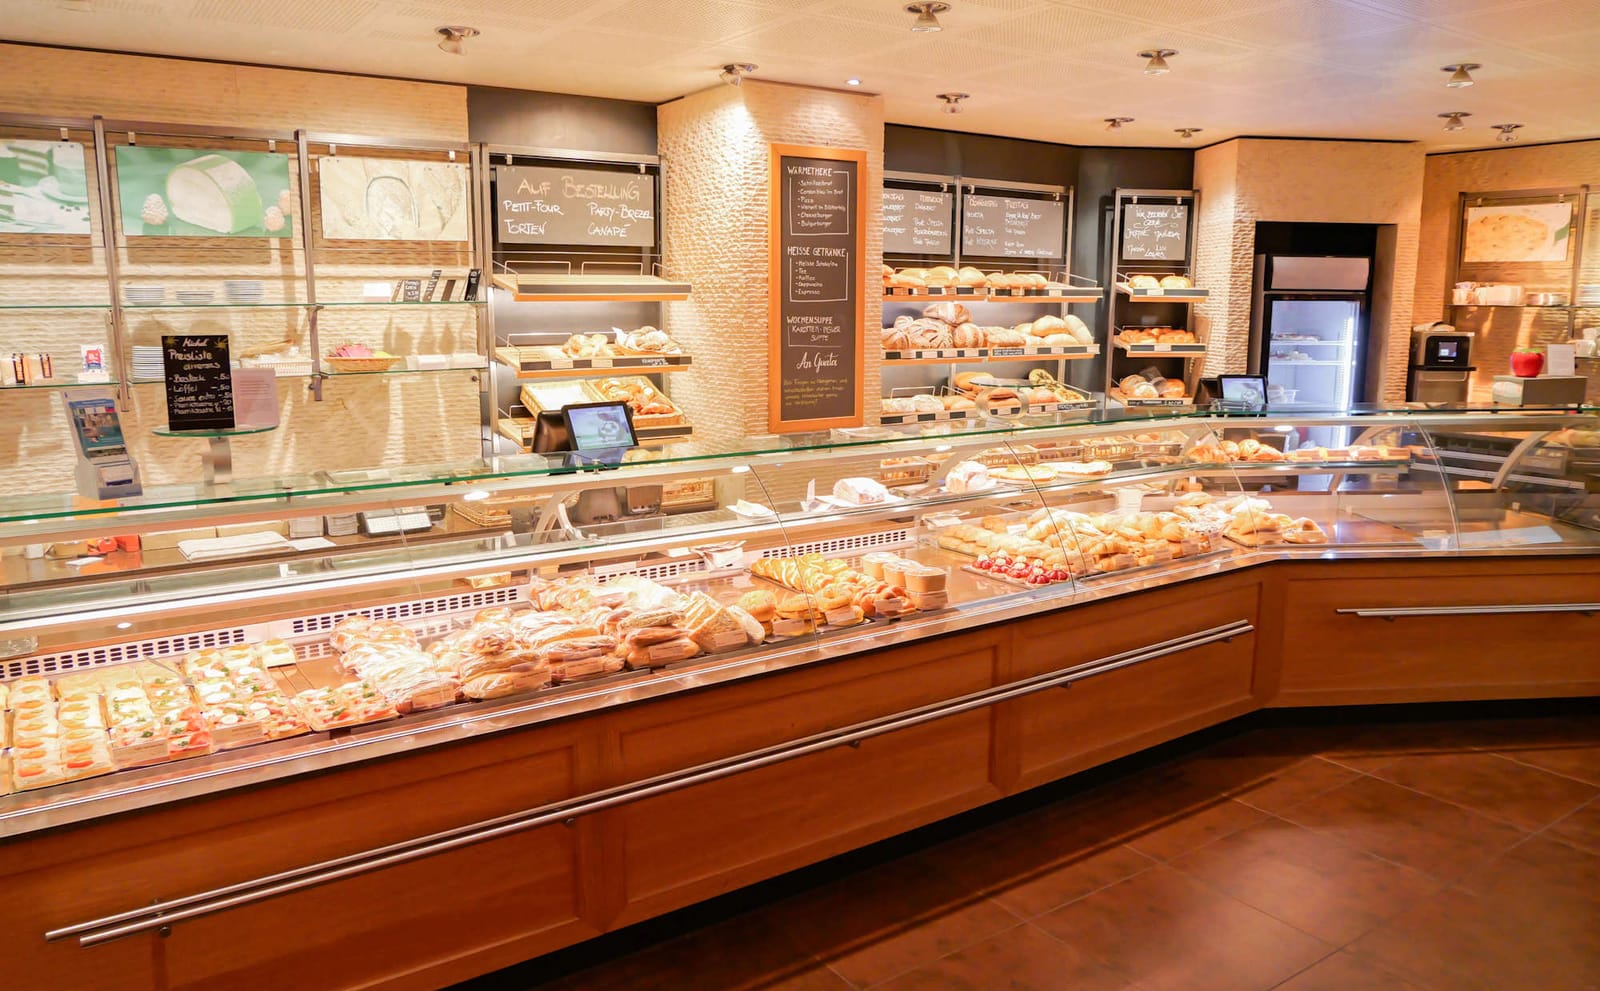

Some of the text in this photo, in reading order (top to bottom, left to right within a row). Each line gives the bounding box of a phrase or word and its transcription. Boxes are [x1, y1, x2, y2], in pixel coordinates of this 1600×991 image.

[517, 175, 640, 201] AUF BESTELLUNG
[503, 200, 564, 215] PETIT-FOUR
[504, 219, 547, 235] TORTEN
[787, 246, 810, 256] HEISSE
[168, 348, 212, 361] Preisliste
